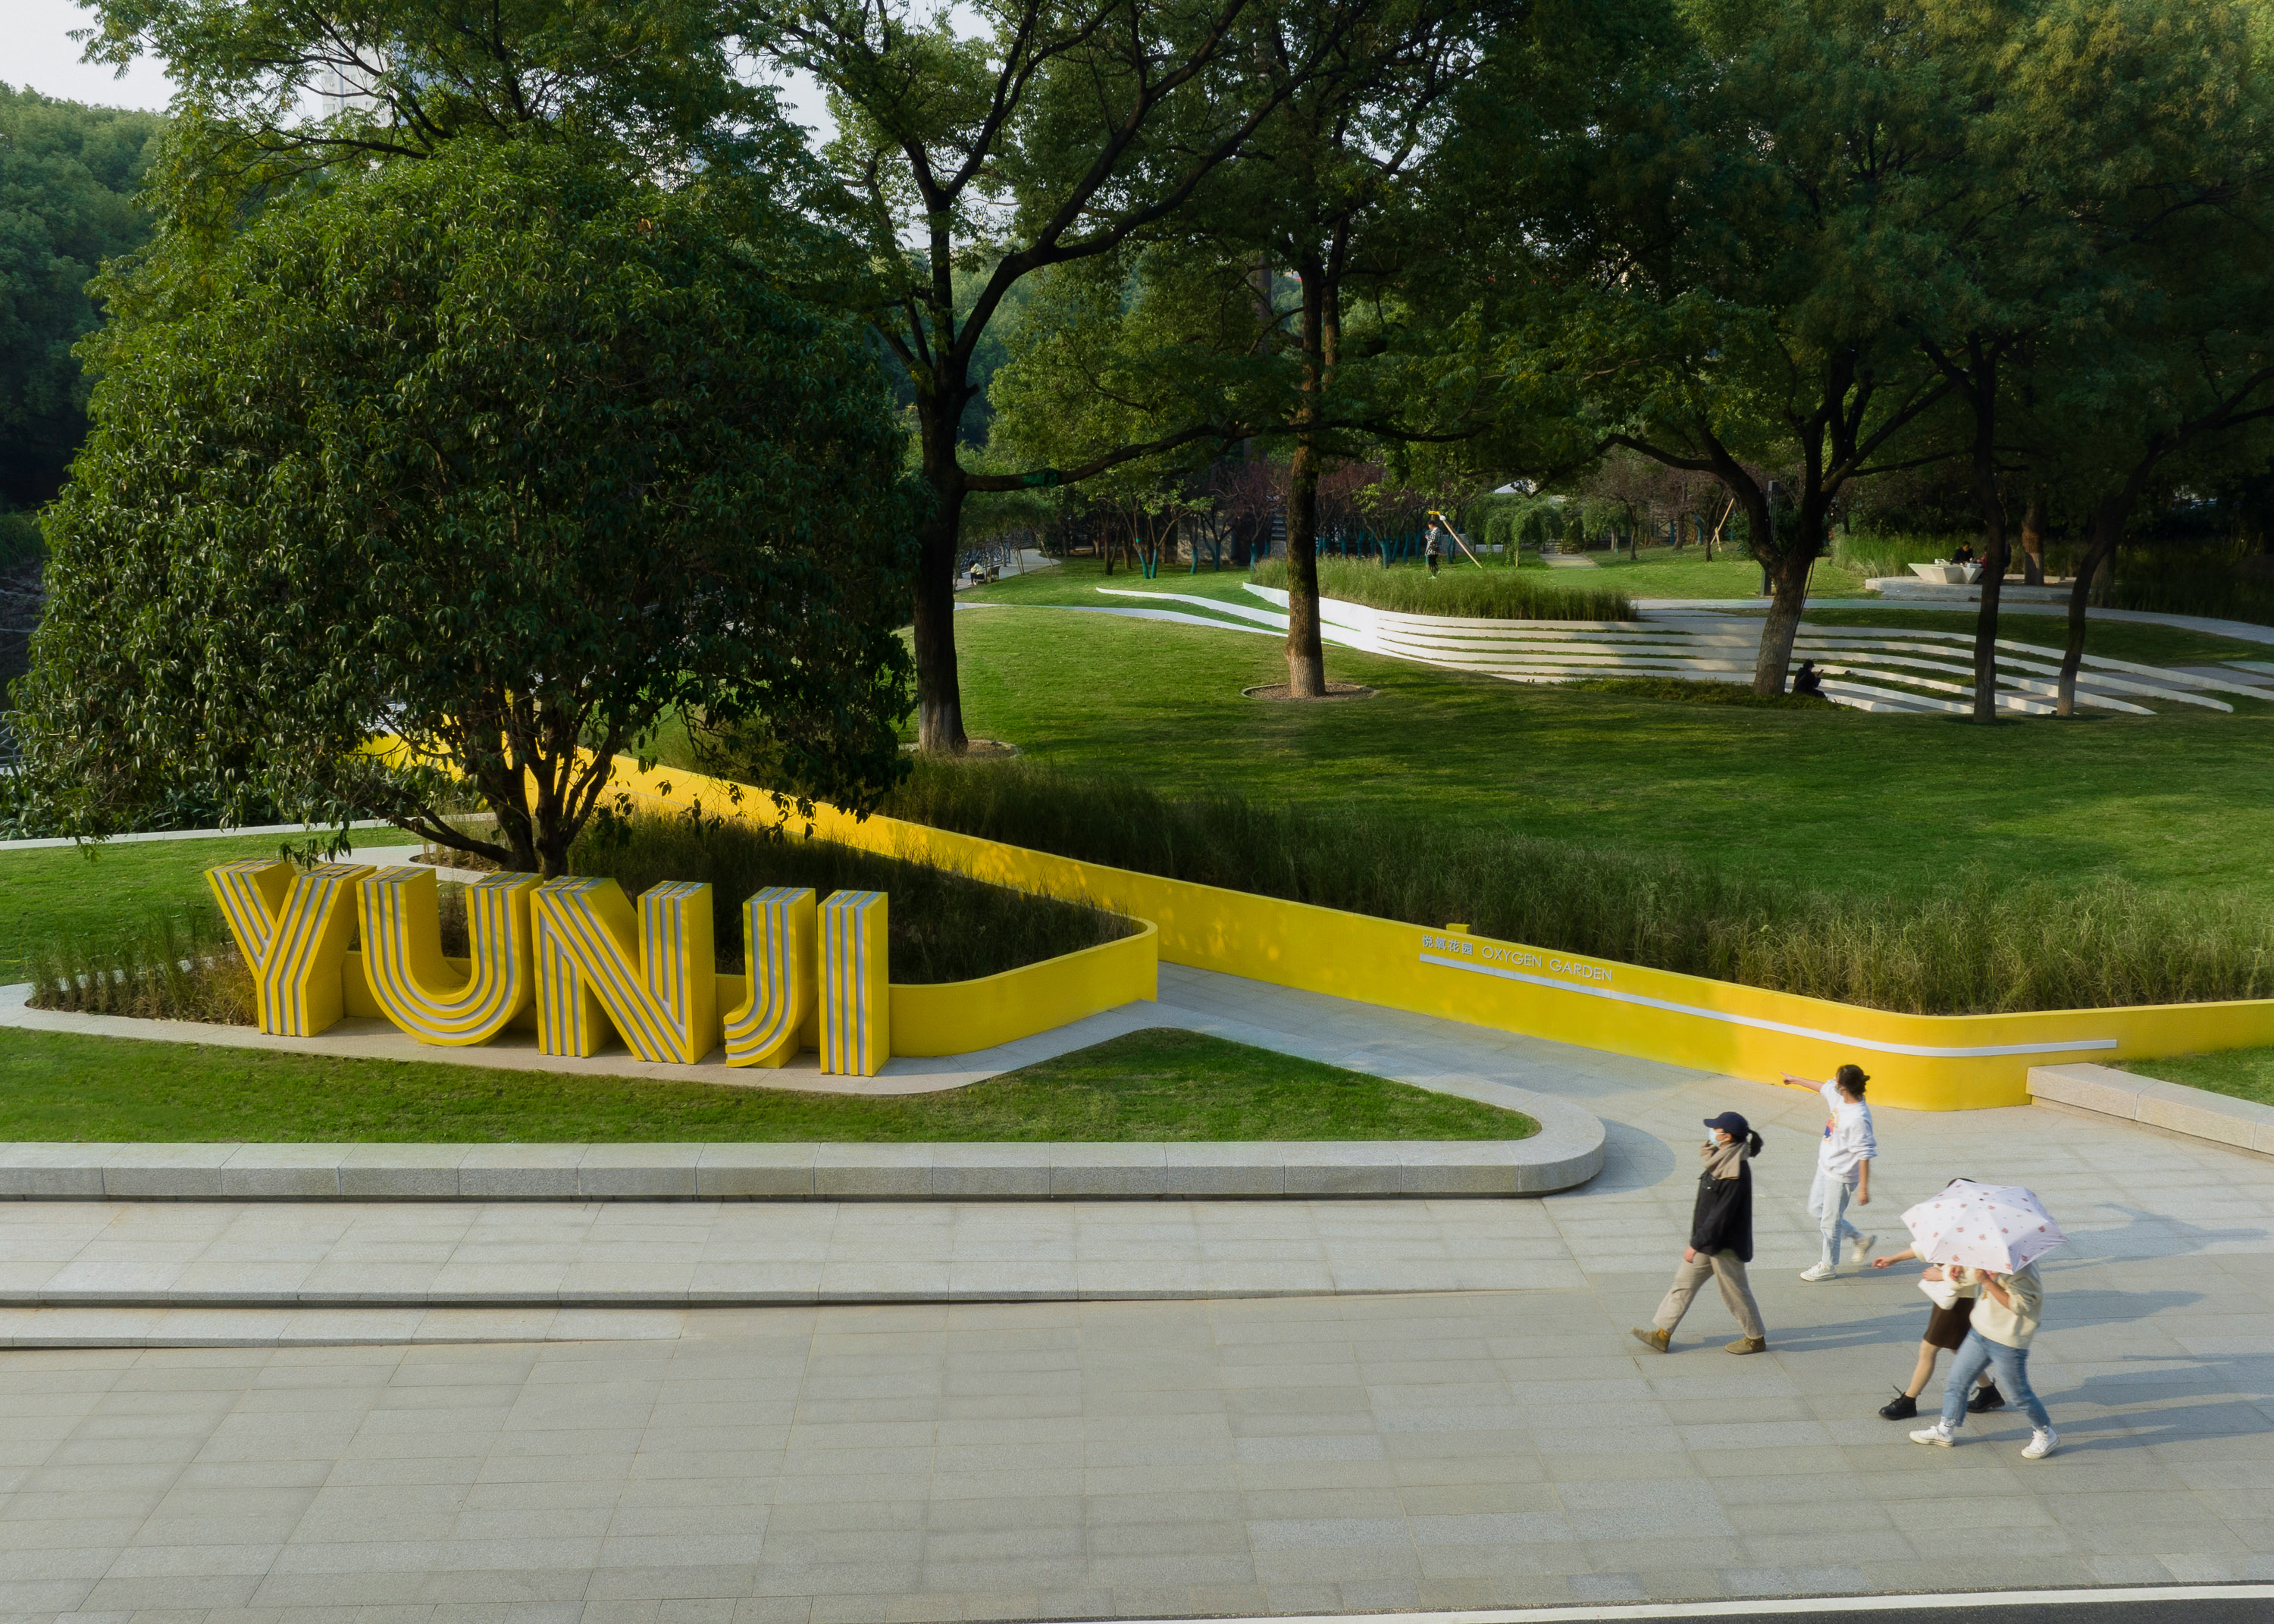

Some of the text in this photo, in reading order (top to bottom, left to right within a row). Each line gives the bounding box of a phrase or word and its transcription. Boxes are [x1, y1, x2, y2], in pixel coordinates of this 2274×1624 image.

[206, 858, 888, 1076] YUNJI
[1422, 934, 1613, 981] 悦氧花园 OXYGEN GARDEN
